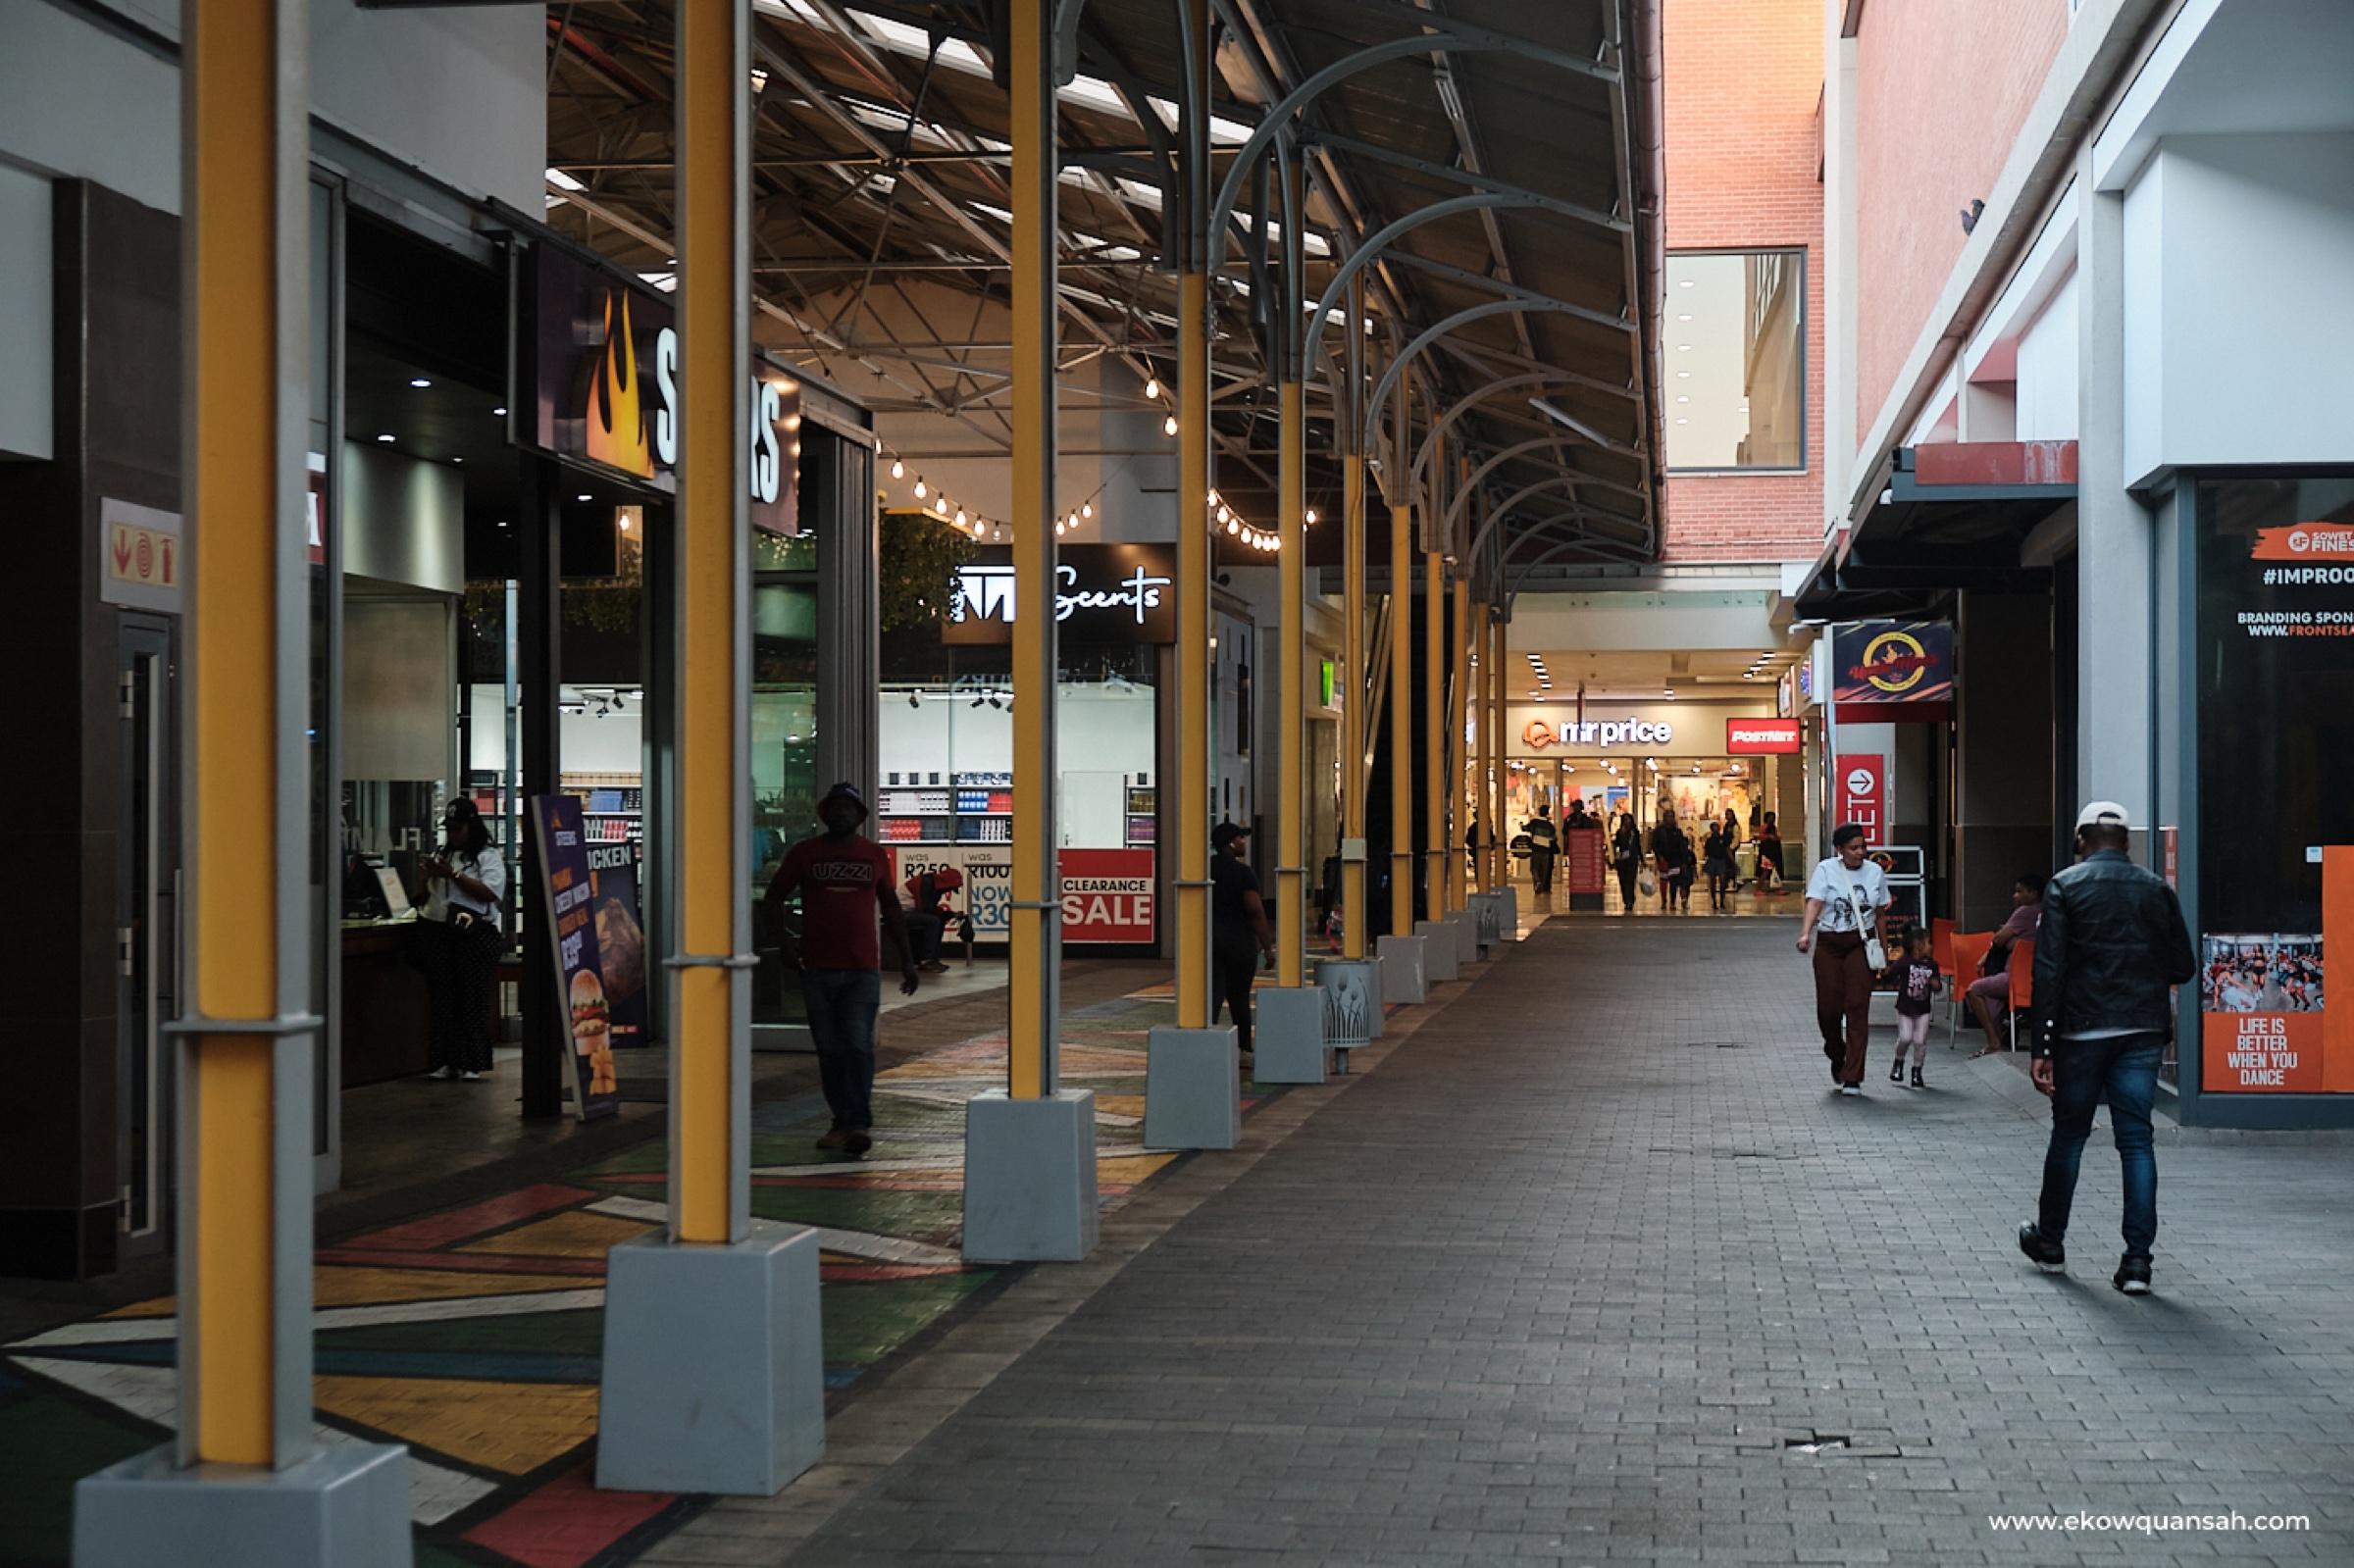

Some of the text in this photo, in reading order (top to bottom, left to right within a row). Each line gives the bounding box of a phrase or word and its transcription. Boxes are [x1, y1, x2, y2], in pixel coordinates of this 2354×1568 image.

[2312, 531, 2354, 540] SOWET
[2237, 612, 2354, 624] BRANDING SPON
[1063, 879, 1147, 891] CLEARANCE
[1062, 895, 1151, 926] SALE
[2239, 1018, 2285, 1035] LIFE IS
[2237, 1036, 2287, 1051] BETTER
[2227, 1052, 2298, 1068] WHEN YOU
[2240, 1069, 2284, 1085] DANCE
